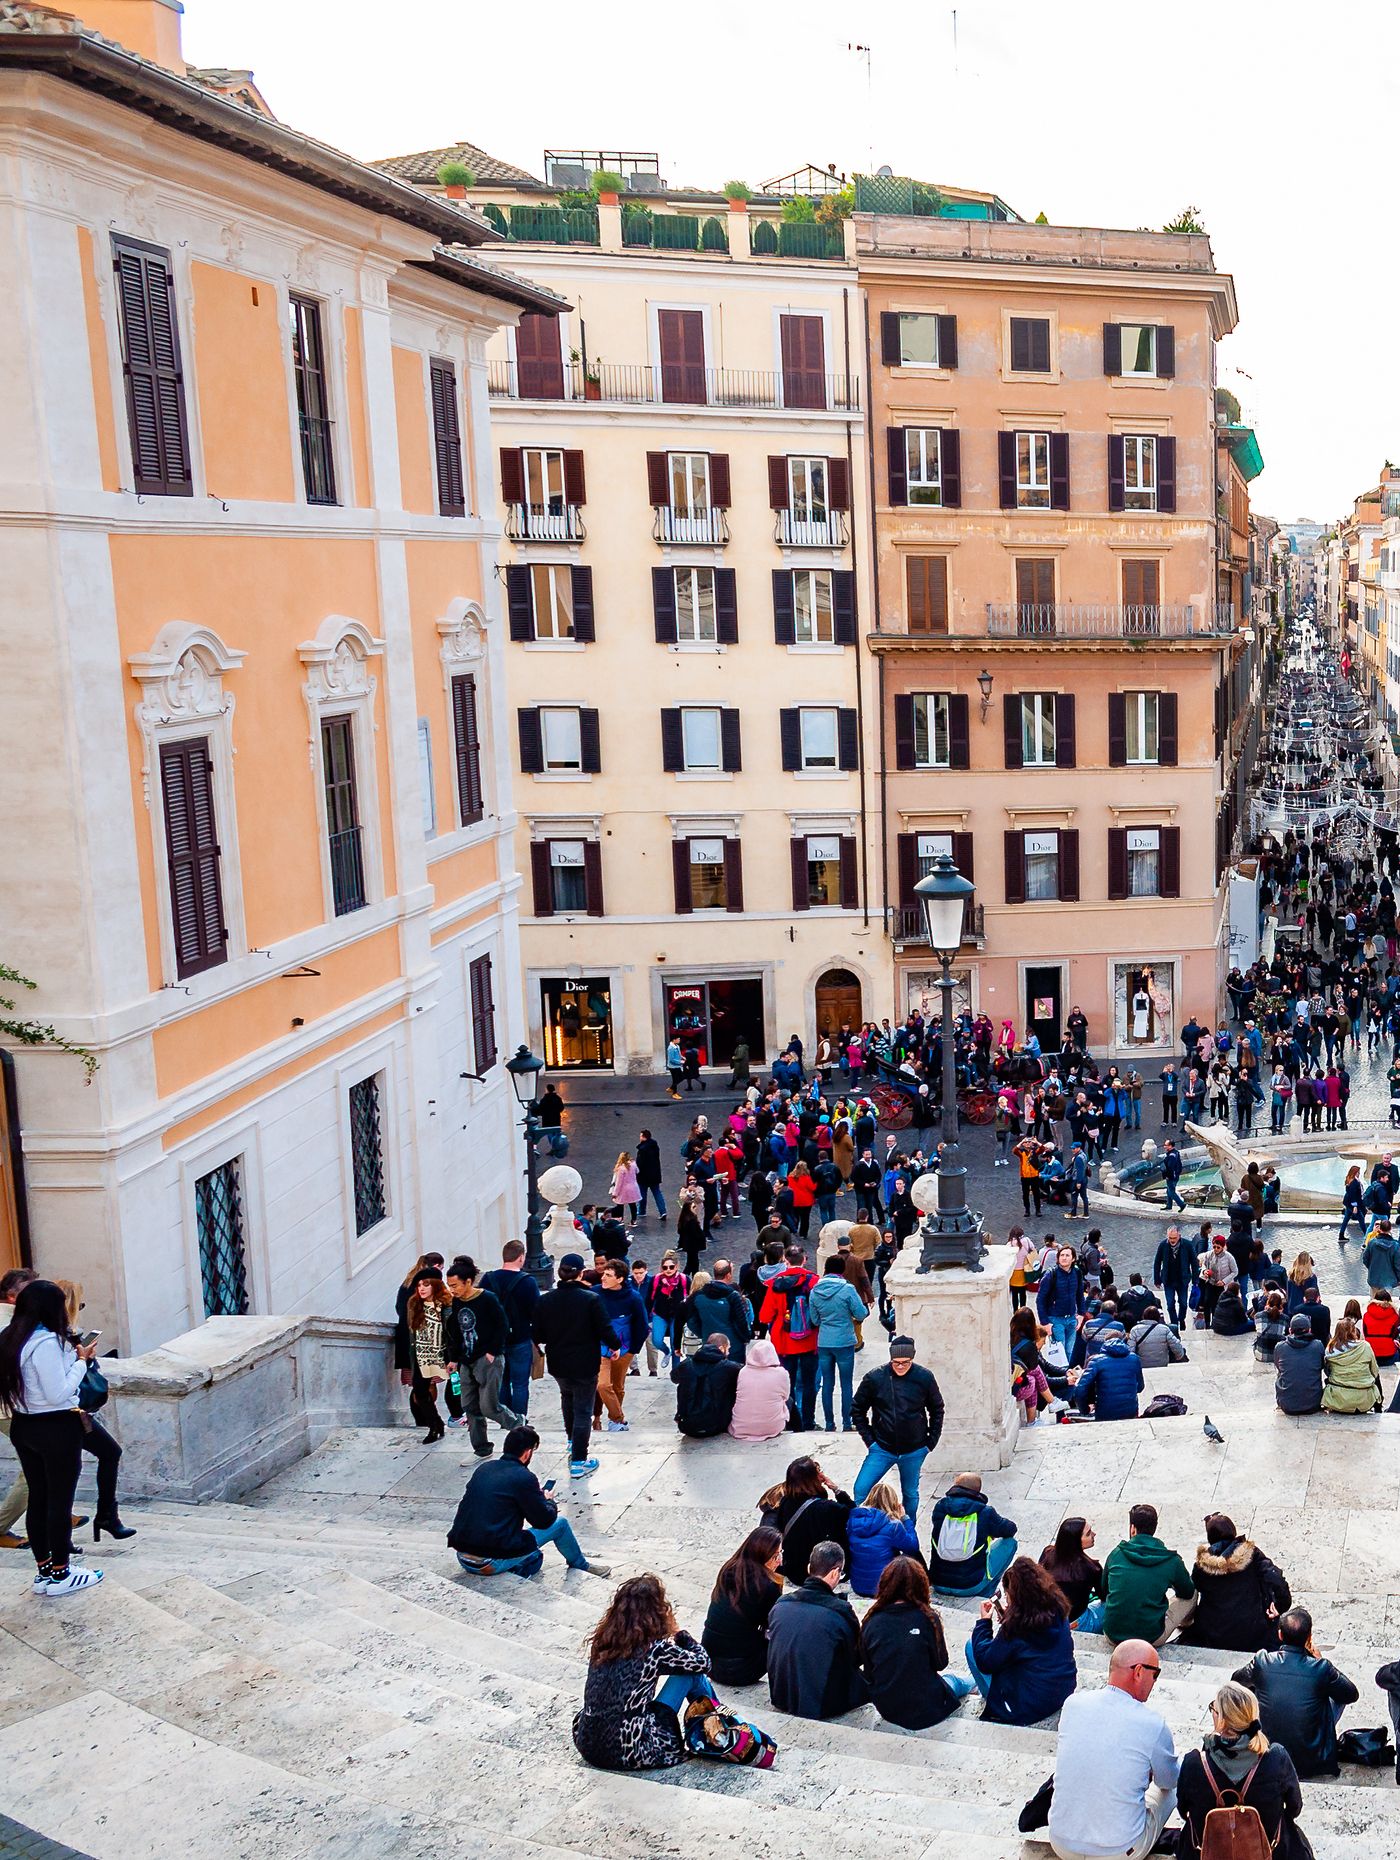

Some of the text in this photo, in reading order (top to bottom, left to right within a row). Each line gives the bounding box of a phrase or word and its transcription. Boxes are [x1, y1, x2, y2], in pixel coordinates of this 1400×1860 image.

[1032, 842, 1052, 852] Dior
[1133, 838, 1153, 848] Dior
[814, 848, 834, 858] Dior
[925, 845, 946, 854] Dior
[557, 854, 579, 864] Dior
[697, 851, 717, 862] Dior
[565, 981, 589, 992] Dior
[673, 989, 700, 1000] CAMPER
